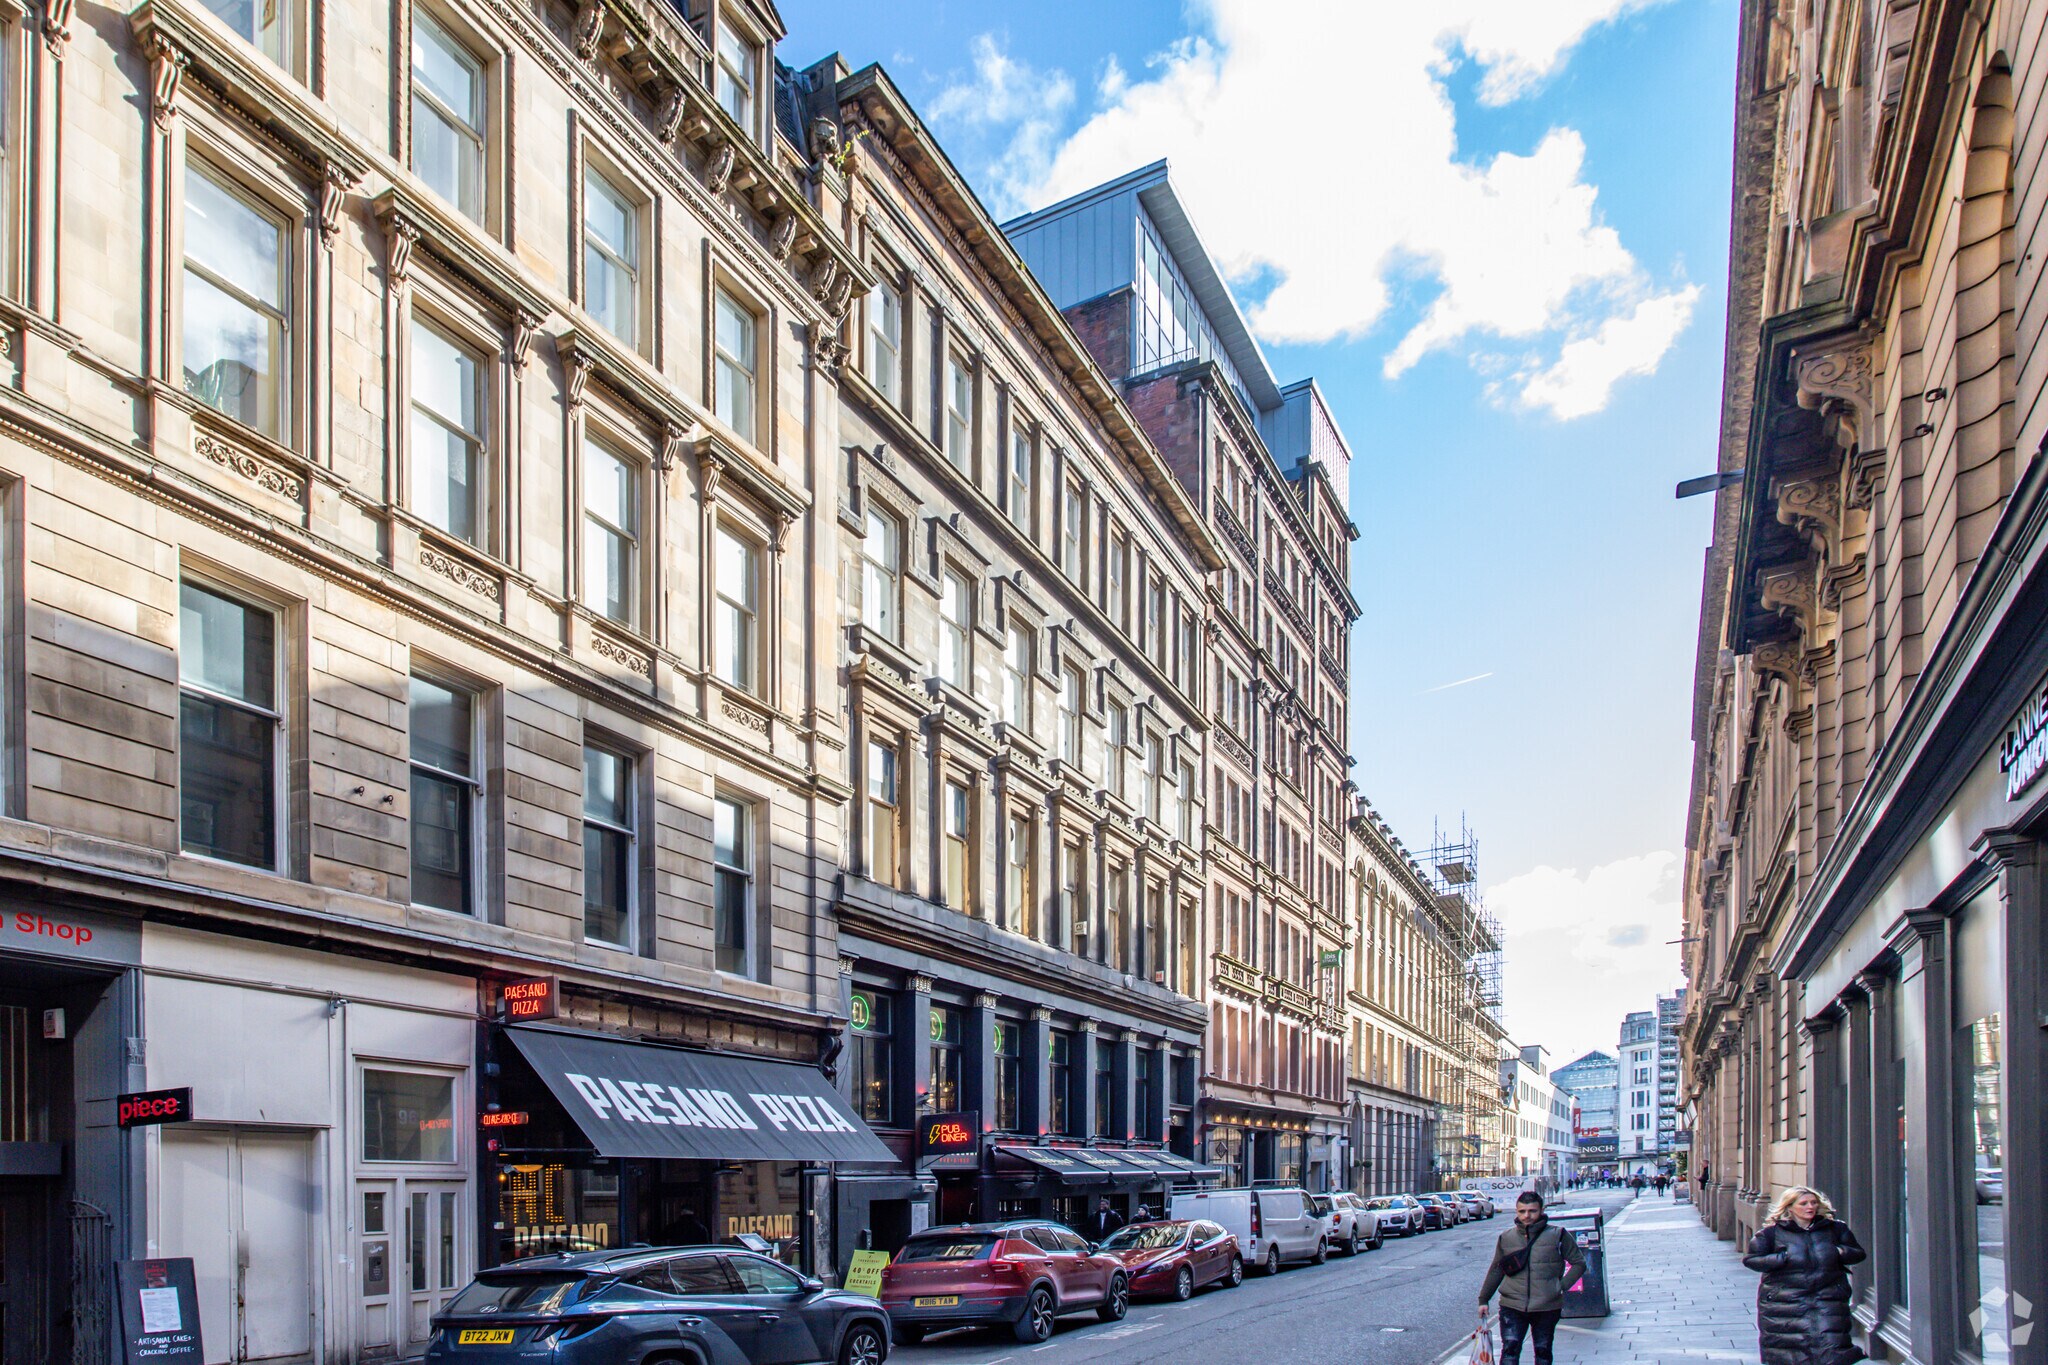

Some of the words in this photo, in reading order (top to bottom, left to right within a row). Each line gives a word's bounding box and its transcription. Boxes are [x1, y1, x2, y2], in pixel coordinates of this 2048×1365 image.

[2006, 722, 2048, 802] JUNIO
[15, 912, 92, 946] Shop
[504, 982, 547, 1000] PAESANO
[512, 1000, 539, 1015] PIZZA
[120, 1096, 177, 1125] piece
[565, 1073, 758, 1129] PAESANO
[748, 1093, 857, 1132] PIZZA
[941, 1124, 961, 1133] PUB
[941, 1133, 968, 1142] DINER
[729, 1214, 793, 1239] PAESANO
[514, 1223, 608, 1257] PAESANO
[138, 1336, 171, 1346] ARTISANAL
[464, 1331, 489, 1341] BT22
[490, 1331, 510, 1341] JXW
[139, 1348, 168, 1356] CRACKING
[169, 1346, 191, 1354] COFFEE
